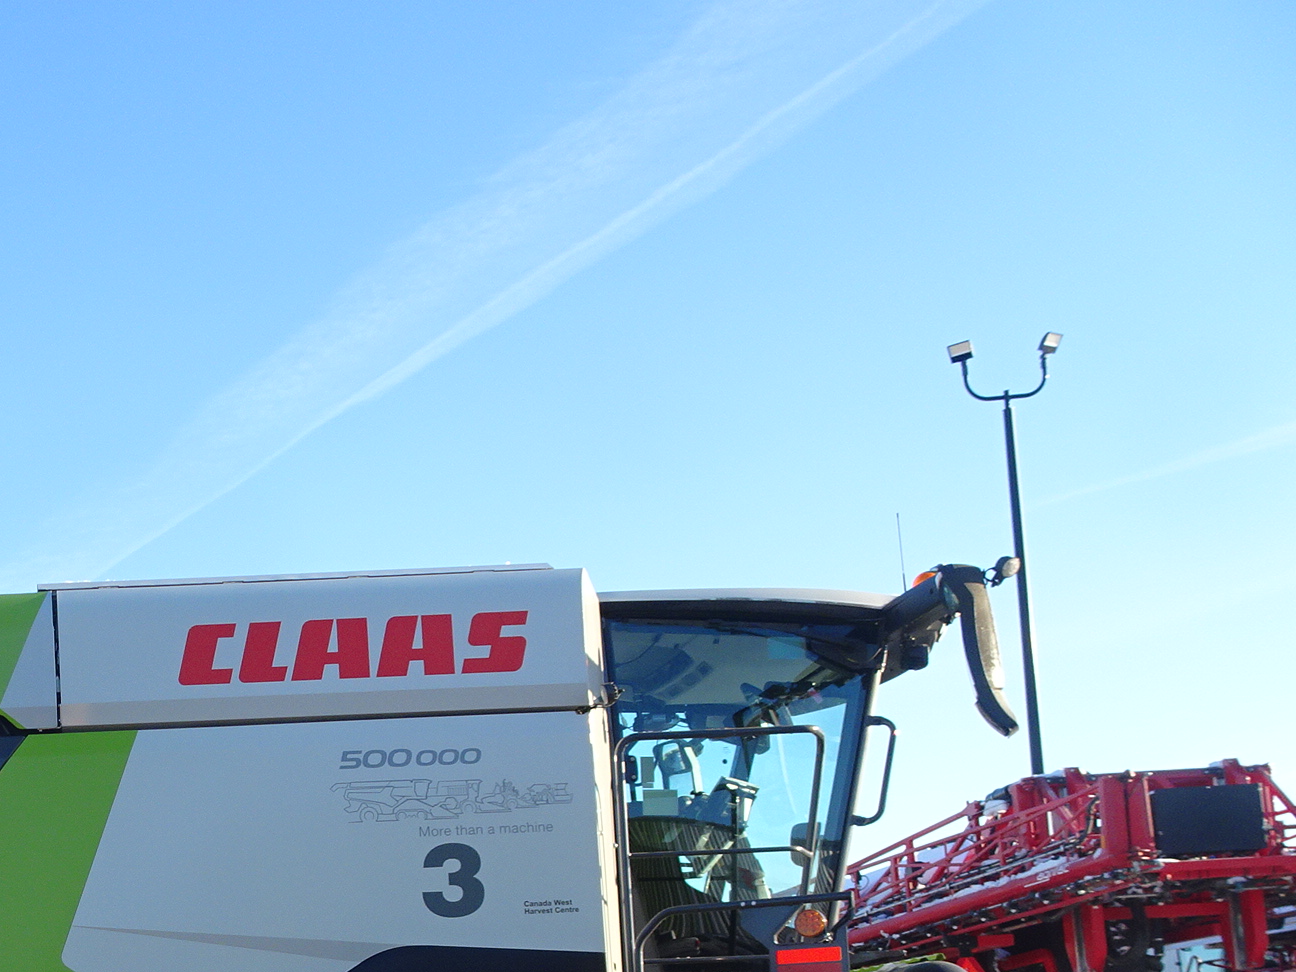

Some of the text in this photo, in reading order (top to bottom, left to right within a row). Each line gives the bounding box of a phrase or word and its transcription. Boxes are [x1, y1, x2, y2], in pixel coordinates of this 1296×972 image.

[178, 610, 529, 686] CLAAS
[339, 747, 482, 770] 500 000
[419, 822, 554, 837] More than a machine
[422, 842, 485, 918] 3
